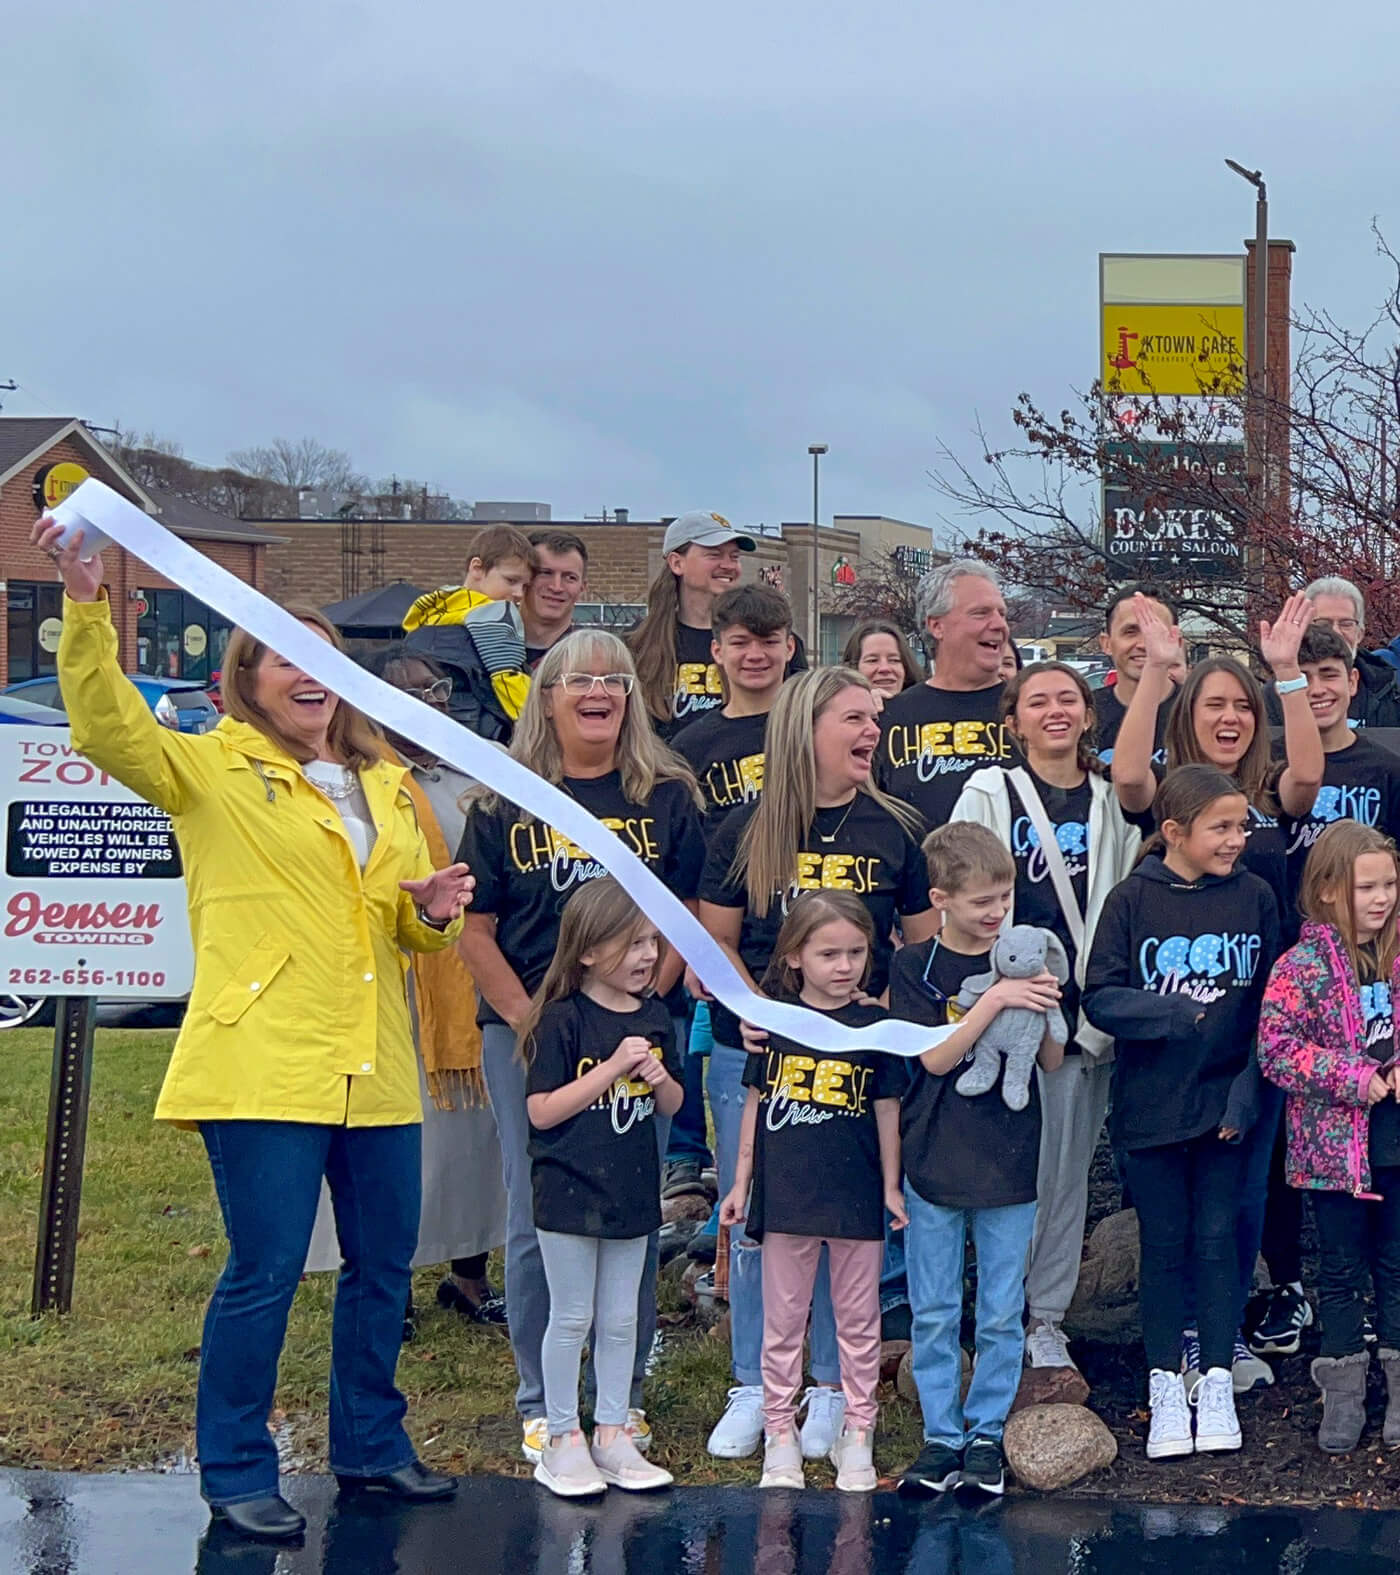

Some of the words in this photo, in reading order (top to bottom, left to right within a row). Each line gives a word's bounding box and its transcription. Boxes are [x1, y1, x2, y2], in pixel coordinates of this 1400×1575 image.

[1202, 336, 1236, 354] CAFE
[1182, 542, 1239, 557] SALOON
[888, 721, 1011, 768] CHEESE
[18, 759, 109, 786] ZO
[917, 745, 976, 782] Crew
[25, 804, 108, 816] ILLEGALLY
[20, 818, 54, 830] AND
[58, 819, 175, 832] UNAUTHORIZED
[27, 833, 104, 845] VEHICLES
[107, 834, 144, 845] WILL
[147, 835, 169, 846] BE
[510, 818, 660, 872] CHSE
[23, 848, 80, 859] TOWED
[82, 848, 102, 859] AT
[105, 848, 173, 861] OWNERS
[50, 862, 121, 874] EXPENSE
[124, 862, 146, 874] BY
[797, 852, 880, 893] EESE
[4, 892, 163, 937] Jensen
[41, 933, 145, 943] TOWING
[8, 968, 165, 986] 262-656-1100
[766, 1083, 834, 1131] Crew
